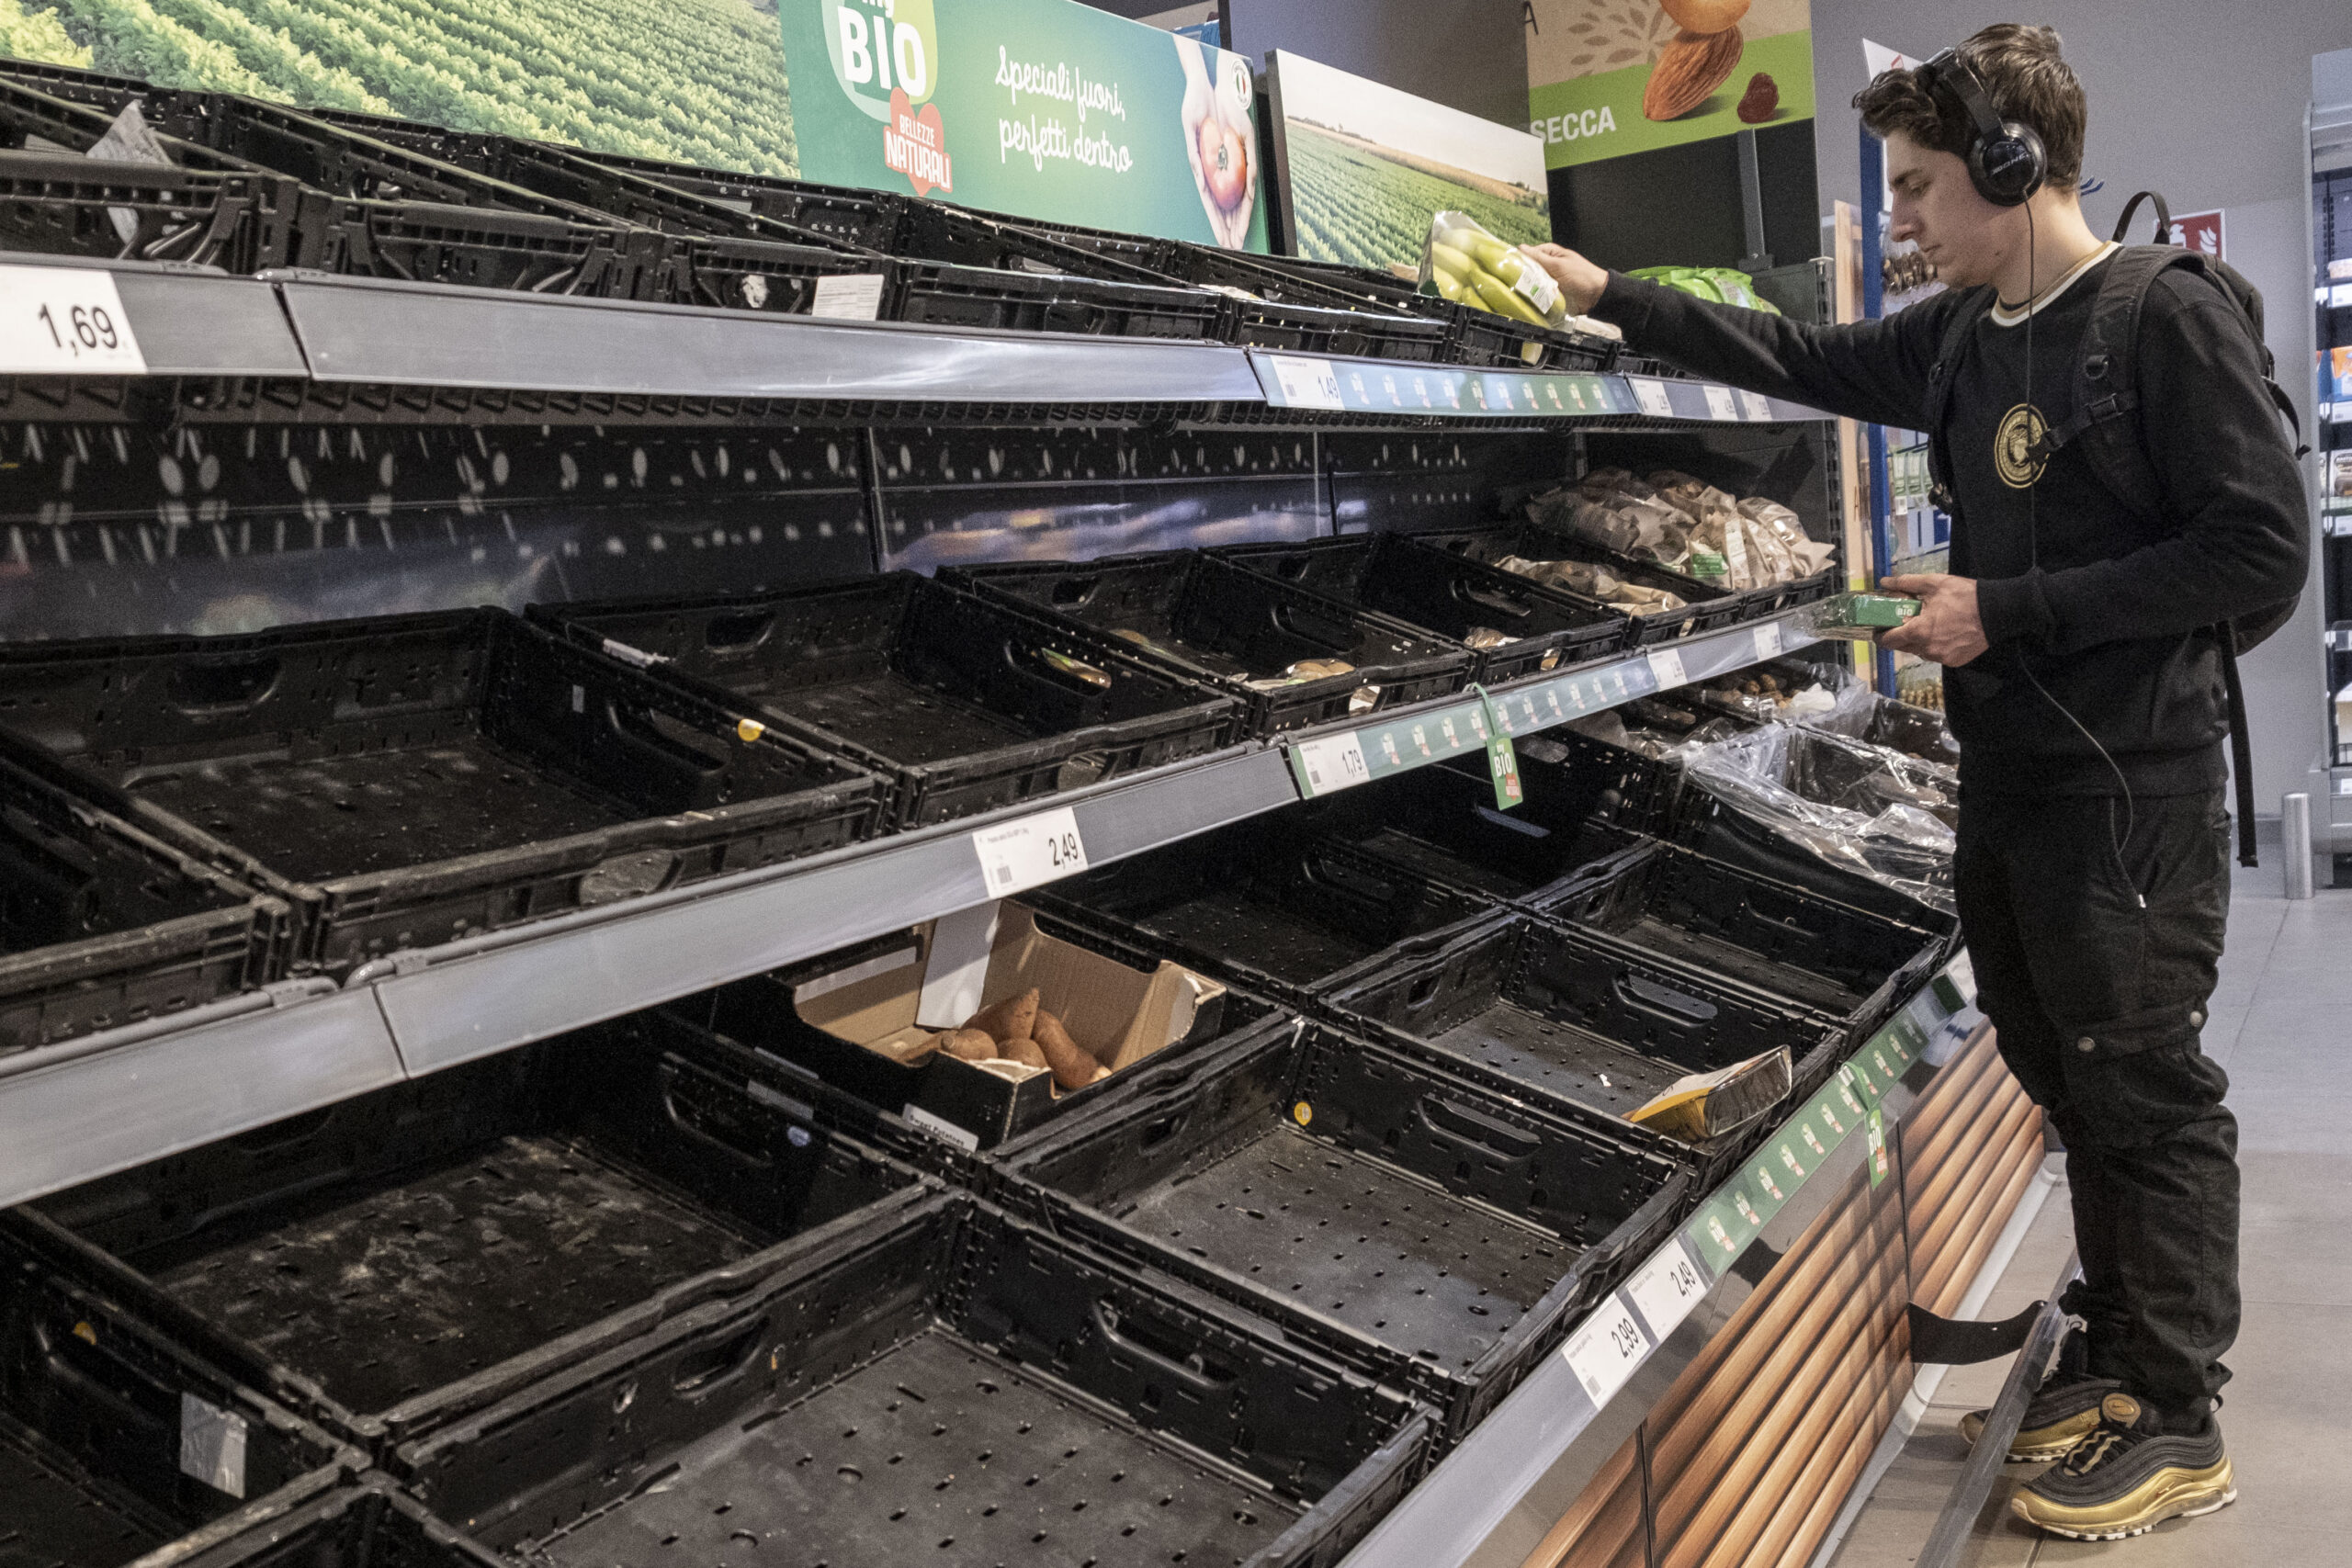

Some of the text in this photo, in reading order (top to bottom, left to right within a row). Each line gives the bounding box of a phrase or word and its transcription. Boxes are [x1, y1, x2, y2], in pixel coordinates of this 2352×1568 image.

[838, 6, 926, 97] BIO
[995, 44, 1074, 106] Speciali
[899, 113, 935, 148] BELLEZZE
[999, 113, 1133, 173] perfetti dentro
[1530, 106, 1617, 145] SECCA
[886, 130, 951, 190] NATURALI
[39, 303, 118, 356] 1,69
[1317, 375, 1339, 403] 1,49
[1341, 749, 1363, 778] 1,79
[1493, 752, 1512, 778] BIO
[1048, 832, 1079, 869] 2,49
[1669, 1260, 1697, 1297] 2,49
[1611, 1318, 1640, 1359] 2,99
